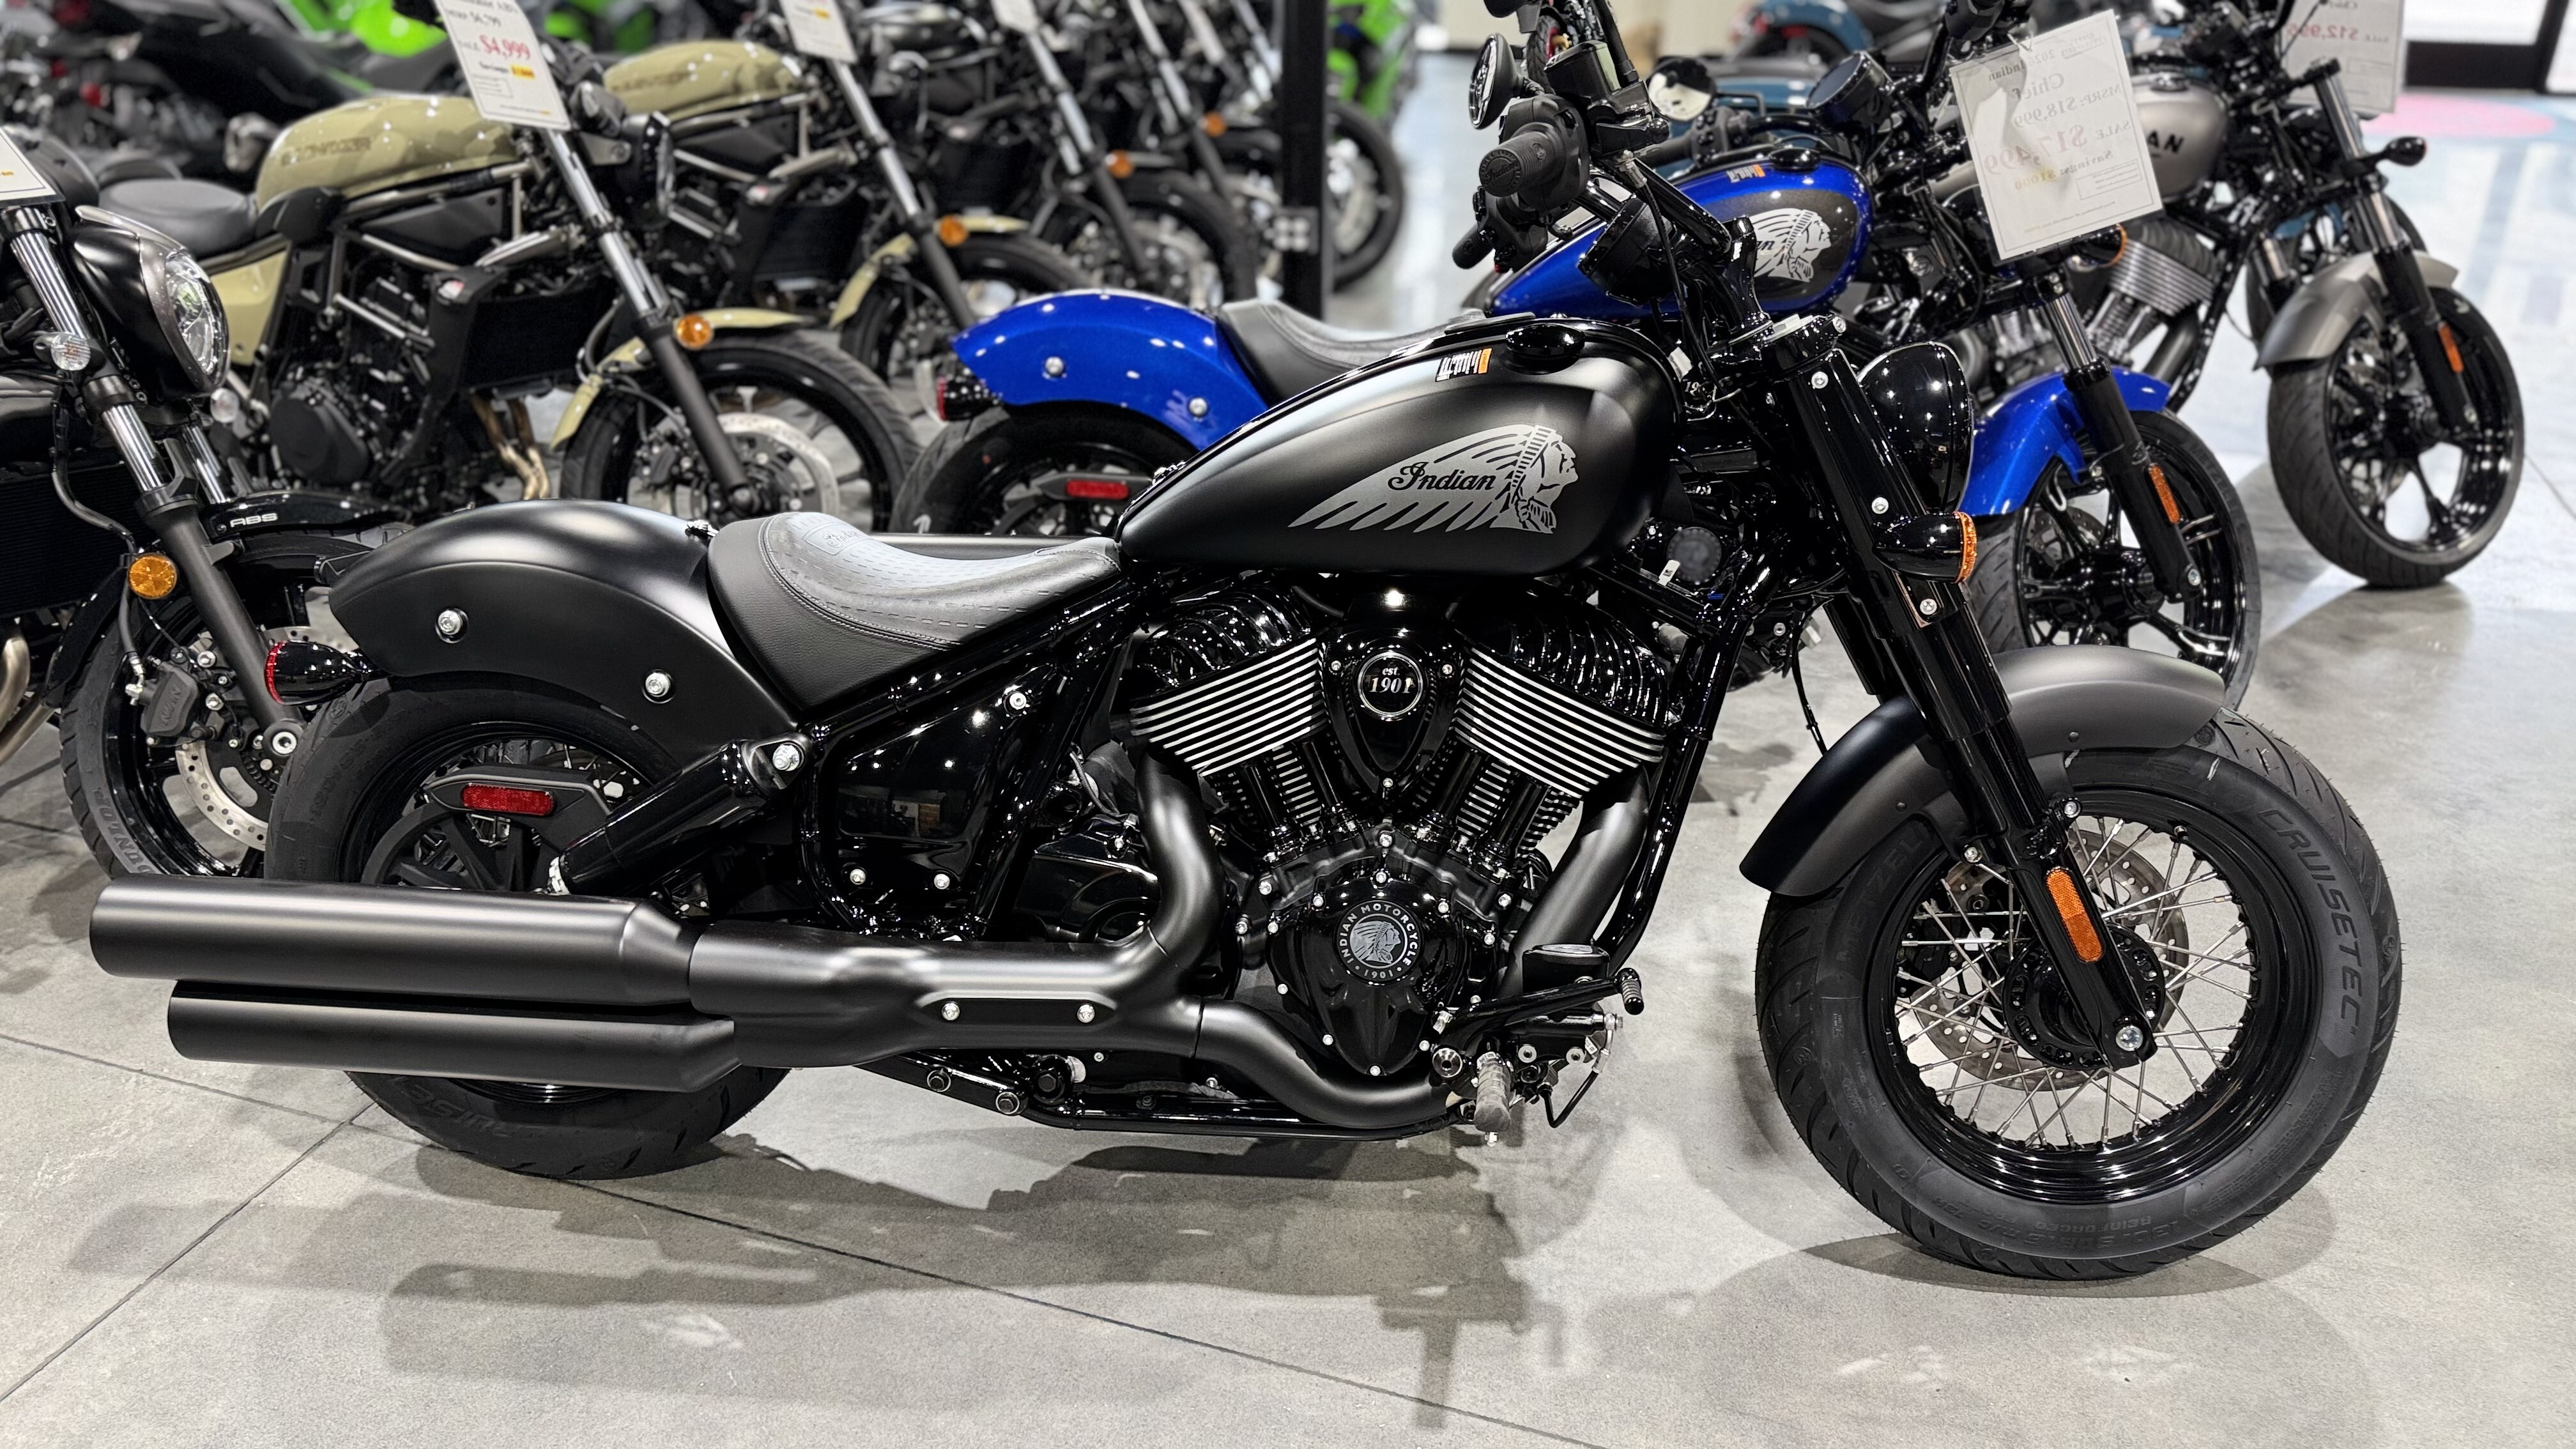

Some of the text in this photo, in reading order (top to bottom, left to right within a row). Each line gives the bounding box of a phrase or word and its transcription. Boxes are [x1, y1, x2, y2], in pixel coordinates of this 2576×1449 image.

[479, 34, 531, 60] $4,999
[1388, 461, 1496, 491] Indian
[229, 512, 278, 528] ABS
[1369, 677, 1412, 694] 1901
[2257, 808, 2363, 1027] CRUISETEC
[1339, 903, 1418, 966] INDIAN MOTORCYCLE
[1363, 969, 1394, 979] 1901
